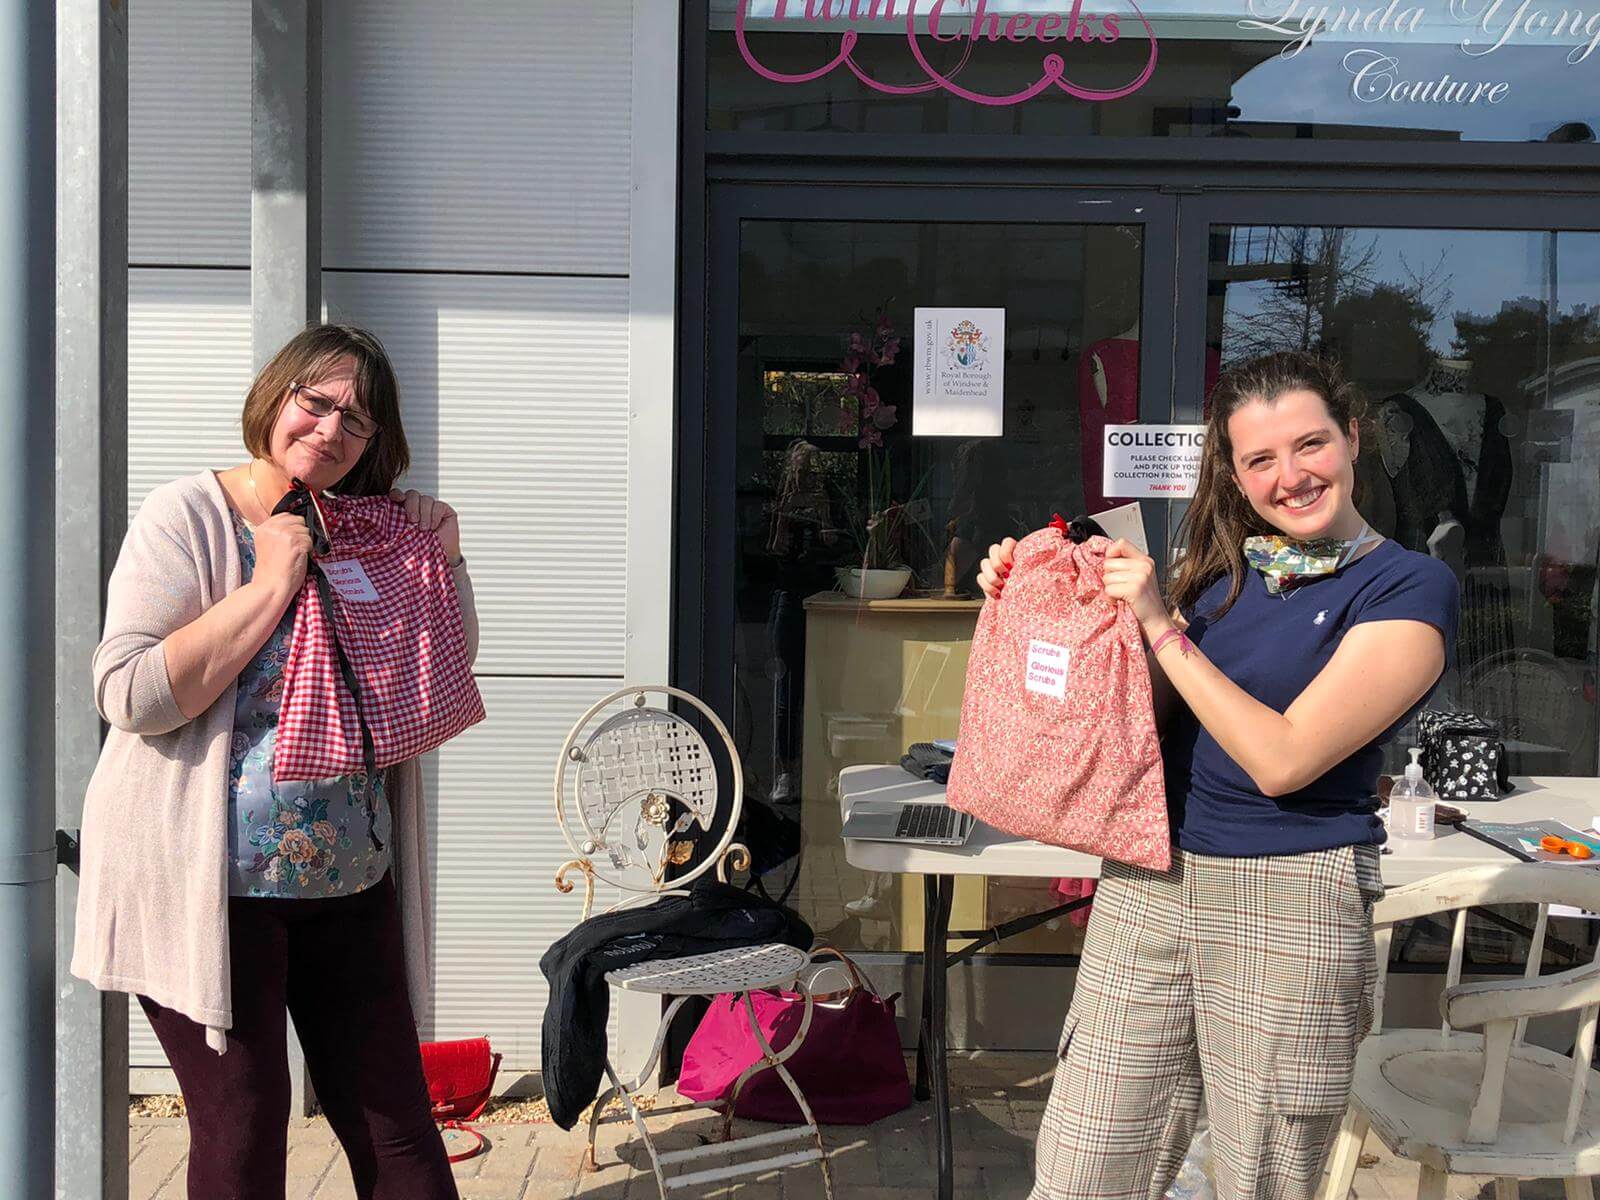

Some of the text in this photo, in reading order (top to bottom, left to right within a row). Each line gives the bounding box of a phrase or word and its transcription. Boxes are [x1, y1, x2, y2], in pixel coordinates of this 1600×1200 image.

[927, 0, 1121, 43] Cheeks
[1236, 0, 1425, 60] Lynda
[1343, 48, 1510, 104] Couture
[941, 371, 992, 382] Royal Borough
[945, 389, 988, 397] Maidenhead
[1108, 432, 1207, 447] COLLECTIO
[1031, 661, 1064, 675] Glorious
[1028, 672, 1055, 685] Scrubs
